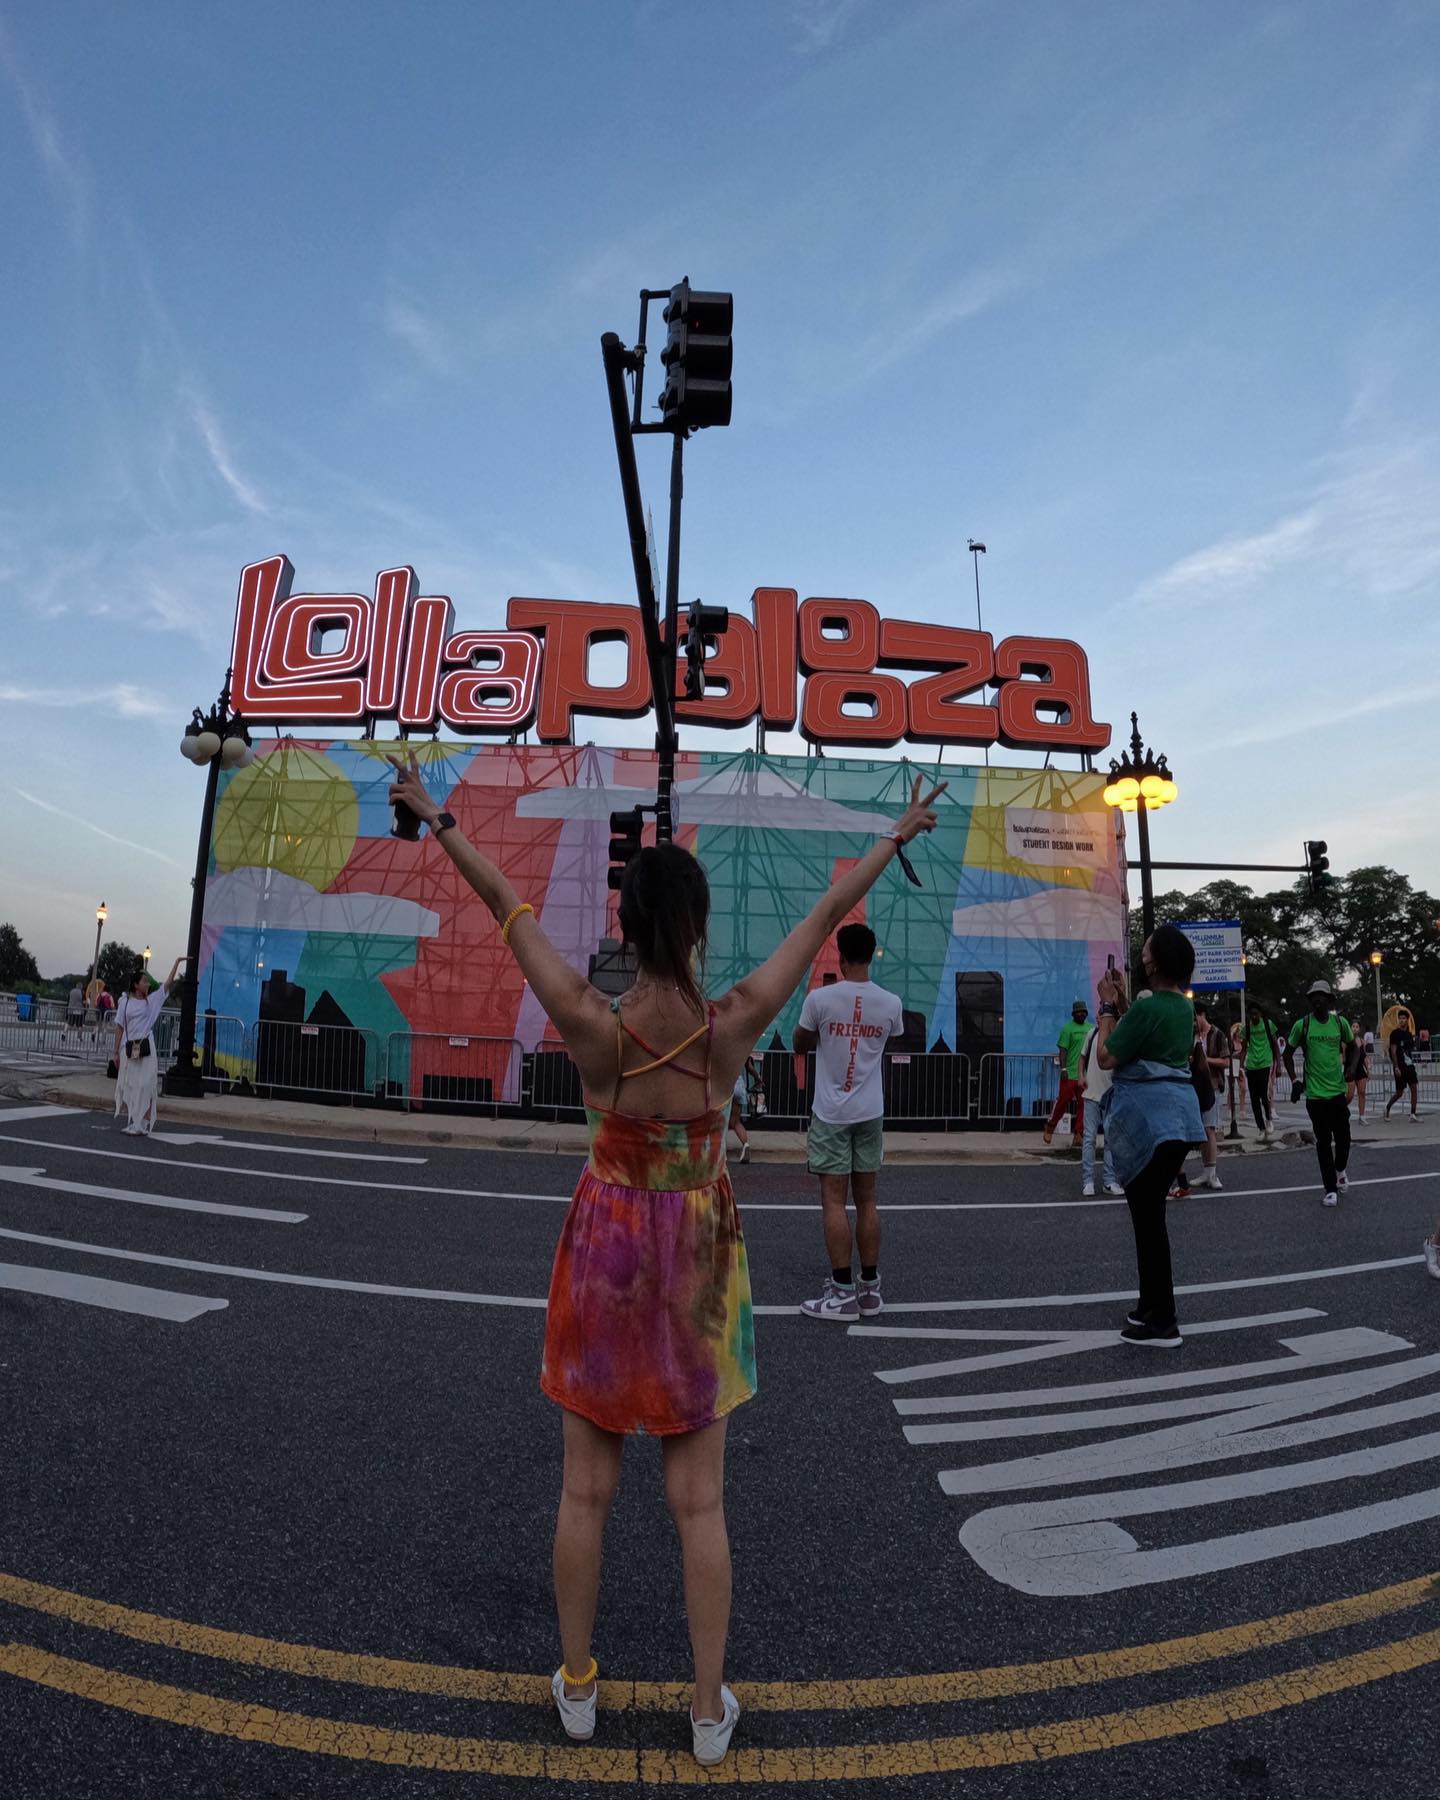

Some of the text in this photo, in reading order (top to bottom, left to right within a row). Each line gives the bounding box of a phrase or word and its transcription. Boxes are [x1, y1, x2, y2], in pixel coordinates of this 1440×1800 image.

[1023, 839, 1093, 852] STUDENT DESIGN WORK
[829, 1022, 884, 1039] FRIENDS
